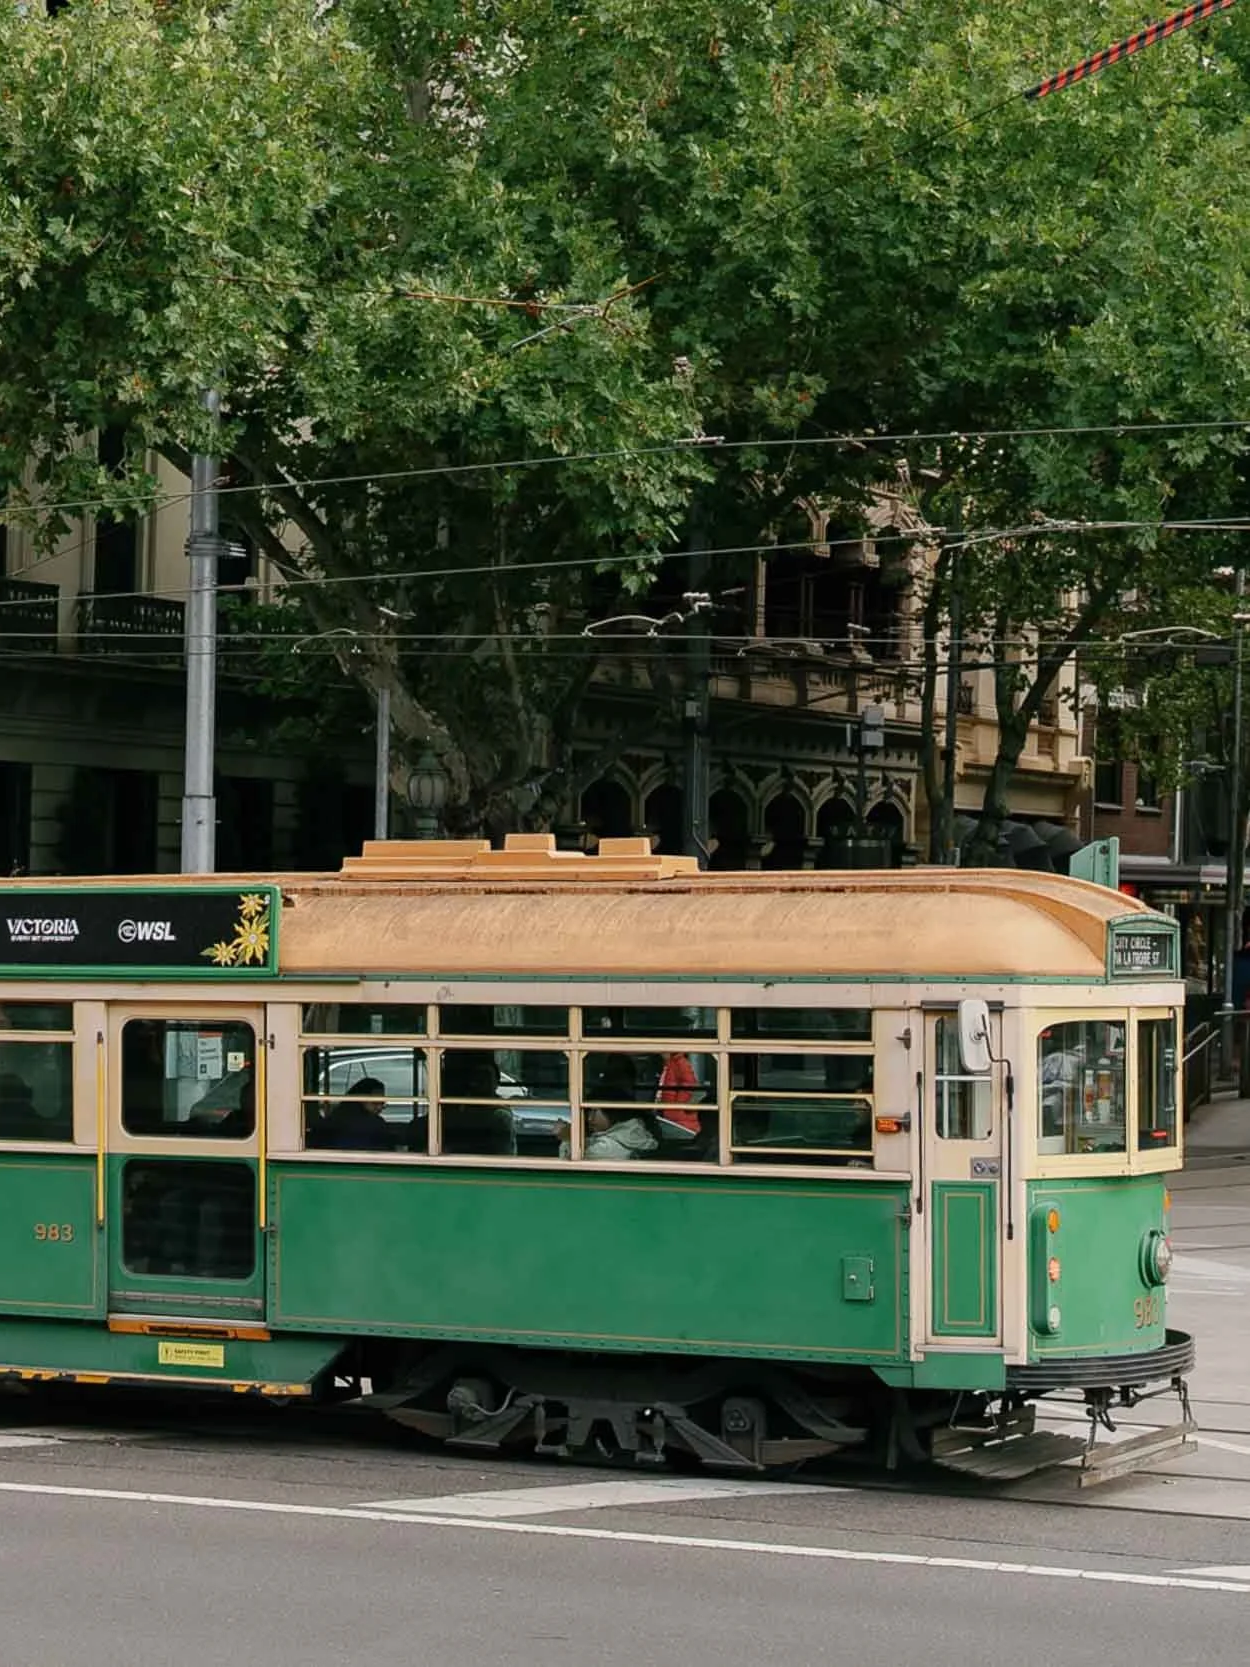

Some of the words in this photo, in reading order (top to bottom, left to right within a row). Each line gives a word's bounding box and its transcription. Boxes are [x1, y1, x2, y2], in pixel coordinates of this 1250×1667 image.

[6, 918, 80, 935] VICTORIA
[137, 921, 177, 941] WSL
[1130, 936, 1152, 950] CIRCLE
[33, 1223, 73, 1242] 983
